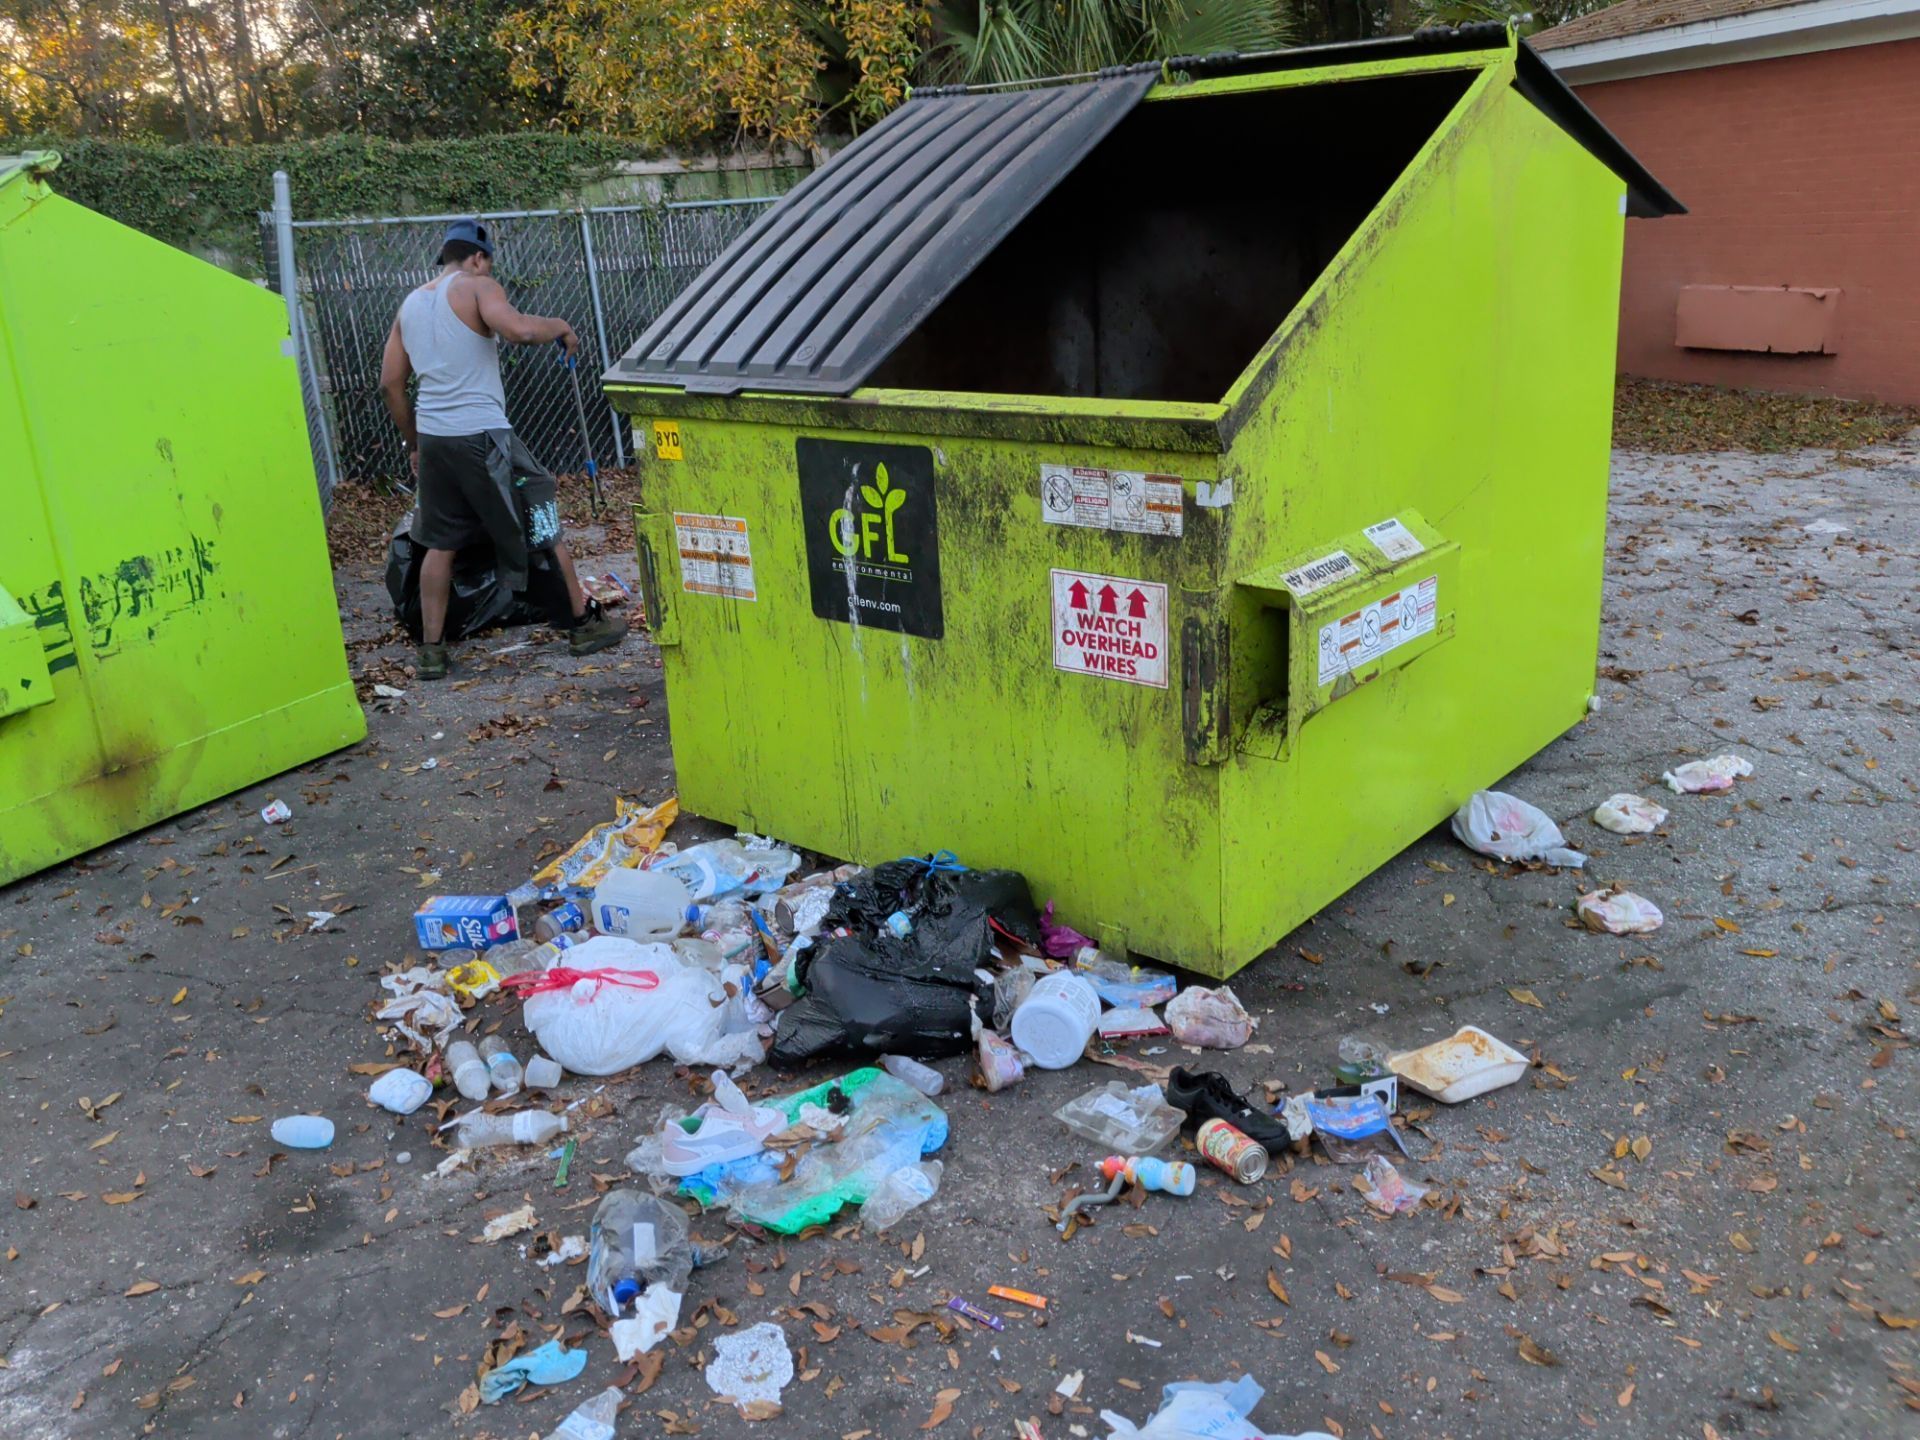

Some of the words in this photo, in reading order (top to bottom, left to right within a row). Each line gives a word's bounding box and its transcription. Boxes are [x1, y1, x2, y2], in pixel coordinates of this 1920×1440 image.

[829, 497, 909, 564] GFL
[832, 561, 913, 580] enronmental
[1302, 555, 1352, 582] WASTEQUIP
[1076, 612, 1142, 639] WATCH
[1061, 629, 1158, 660] OVERHEAD
[1082, 652, 1137, 676] WIRES
[461, 916, 487, 949] Silk
